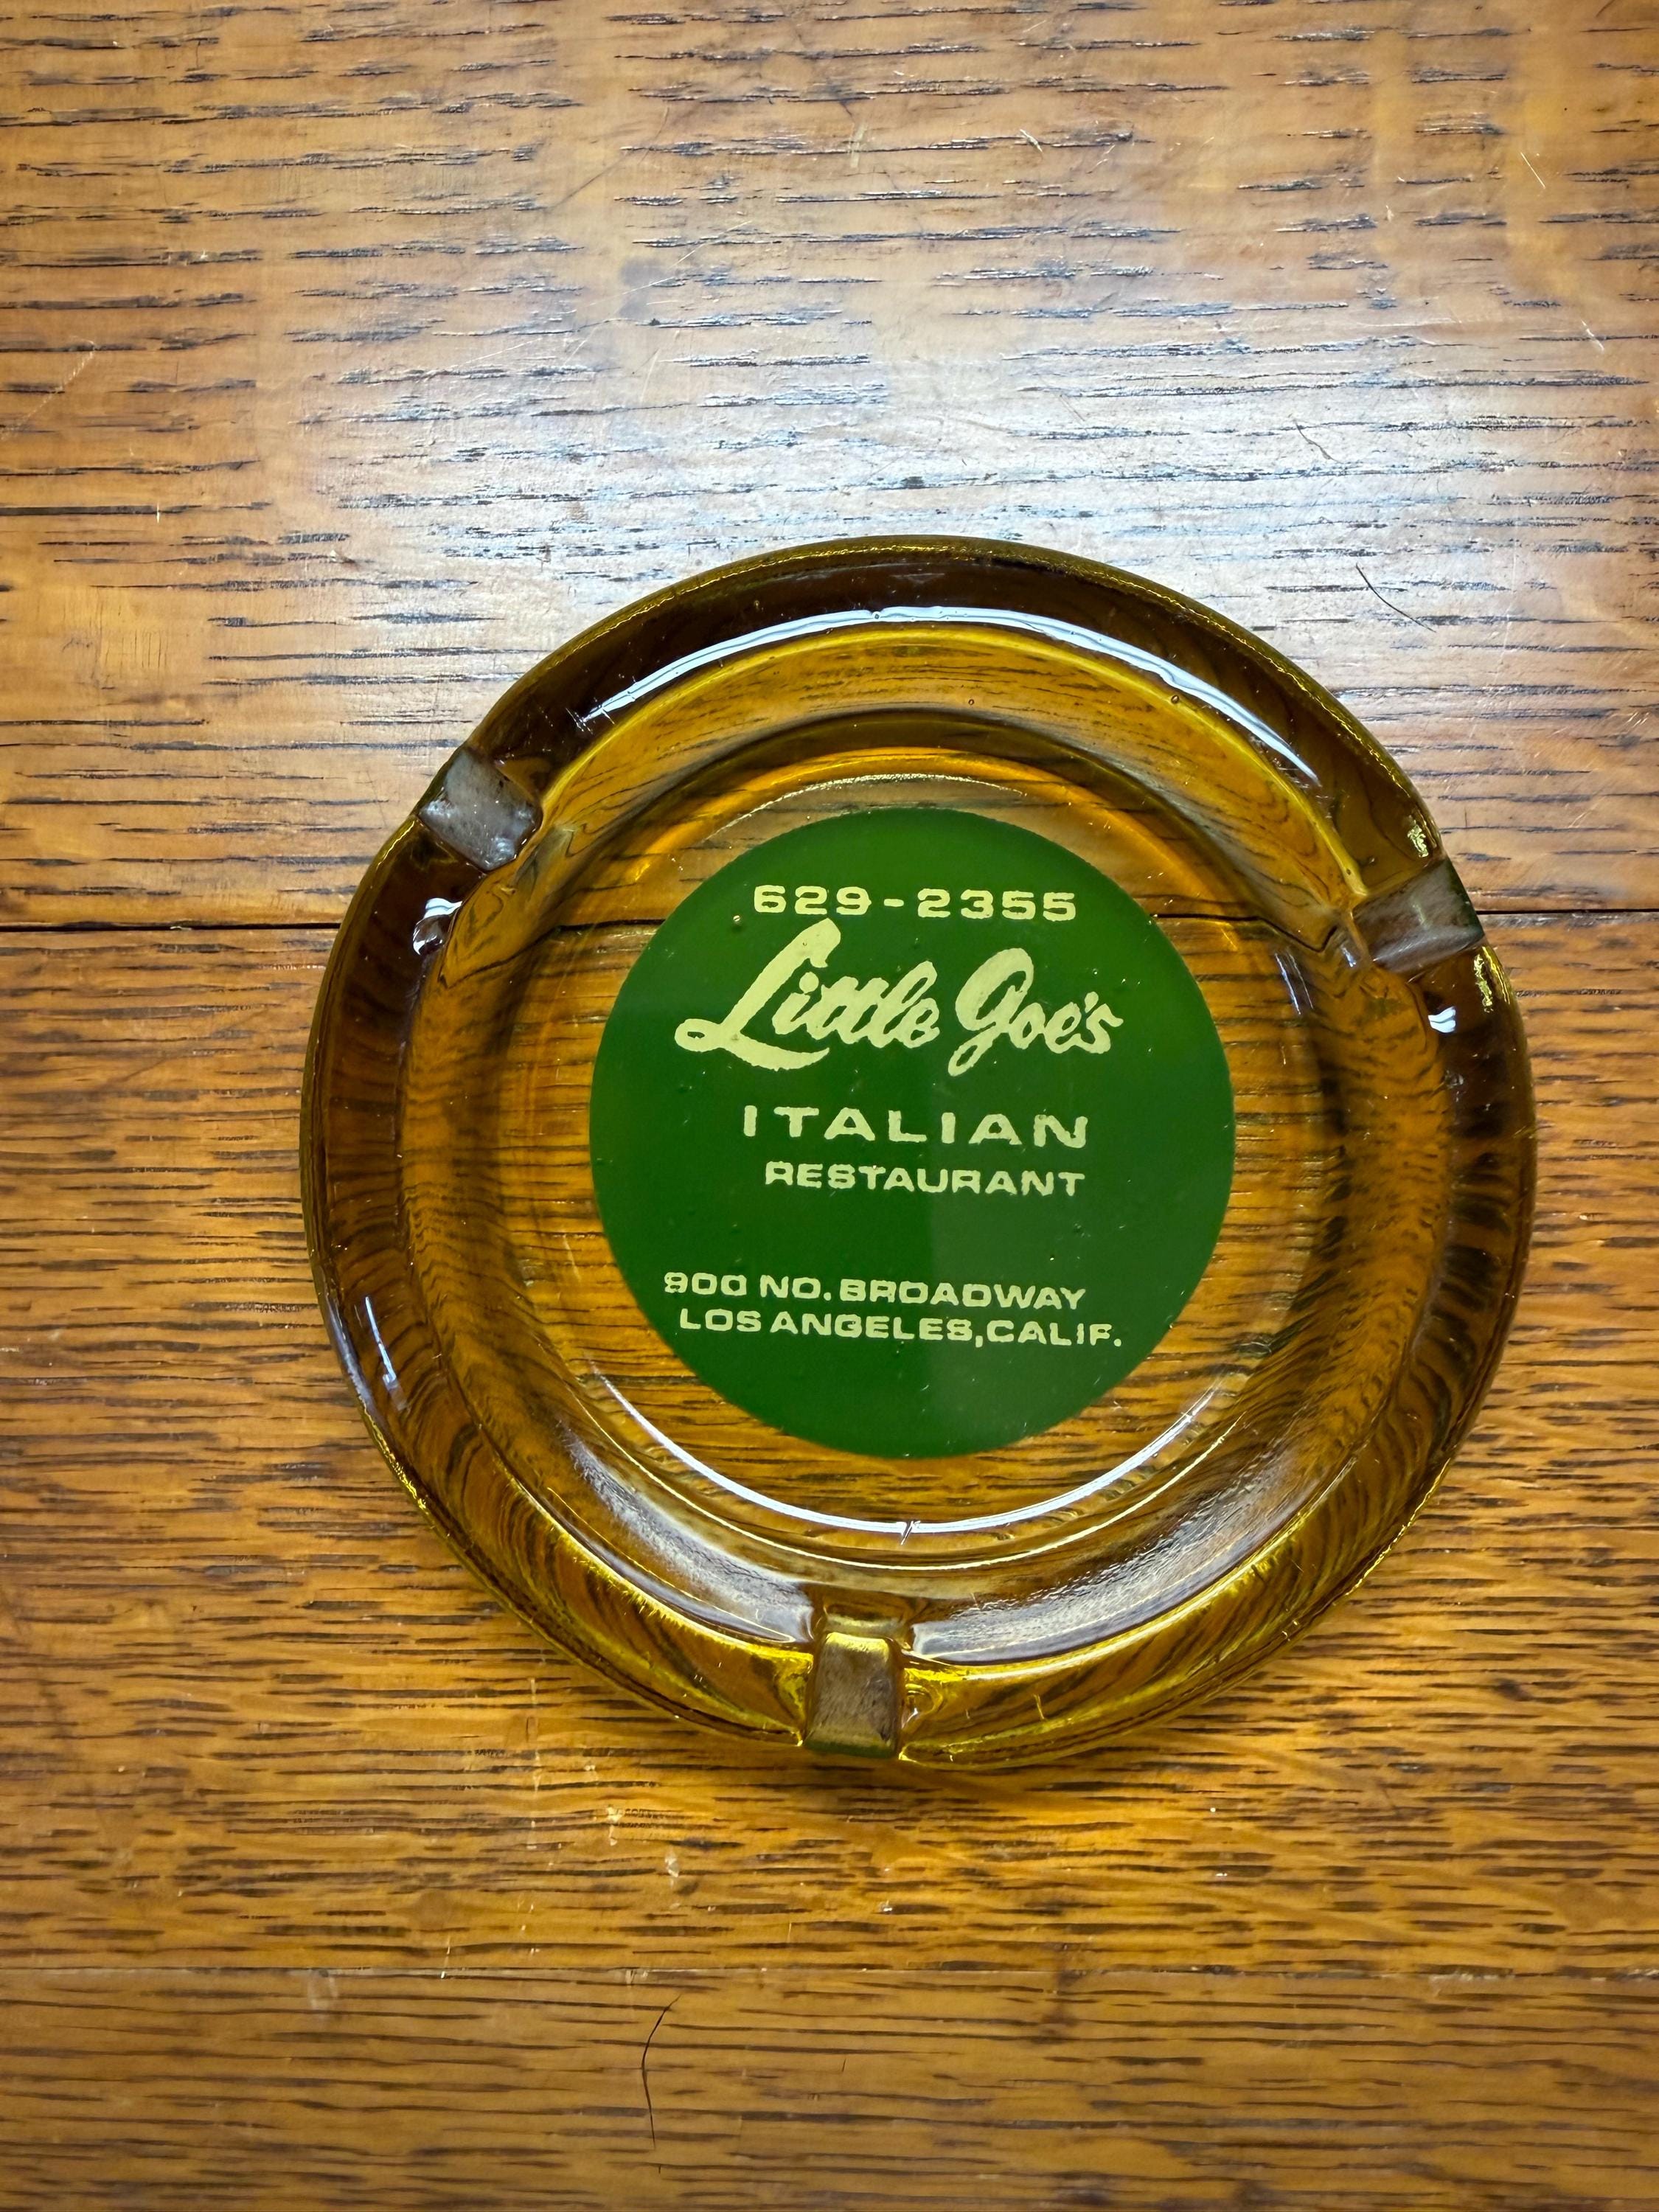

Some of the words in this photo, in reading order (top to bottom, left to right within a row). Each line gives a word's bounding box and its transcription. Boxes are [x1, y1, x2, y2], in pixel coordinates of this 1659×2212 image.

[754, 884, 1077, 922] 629-2355
[674, 917, 940, 1072] Little
[743, 1105, 1088, 1149] ITALIAN
[765, 1161, 1085, 1197] RESTAURANT
[664, 1272, 747, 1296] 900
[759, 1274, 832, 1301] NO.
[839, 1279, 1086, 1310] BROADWAY
[679, 1308, 762, 1332] LOS
